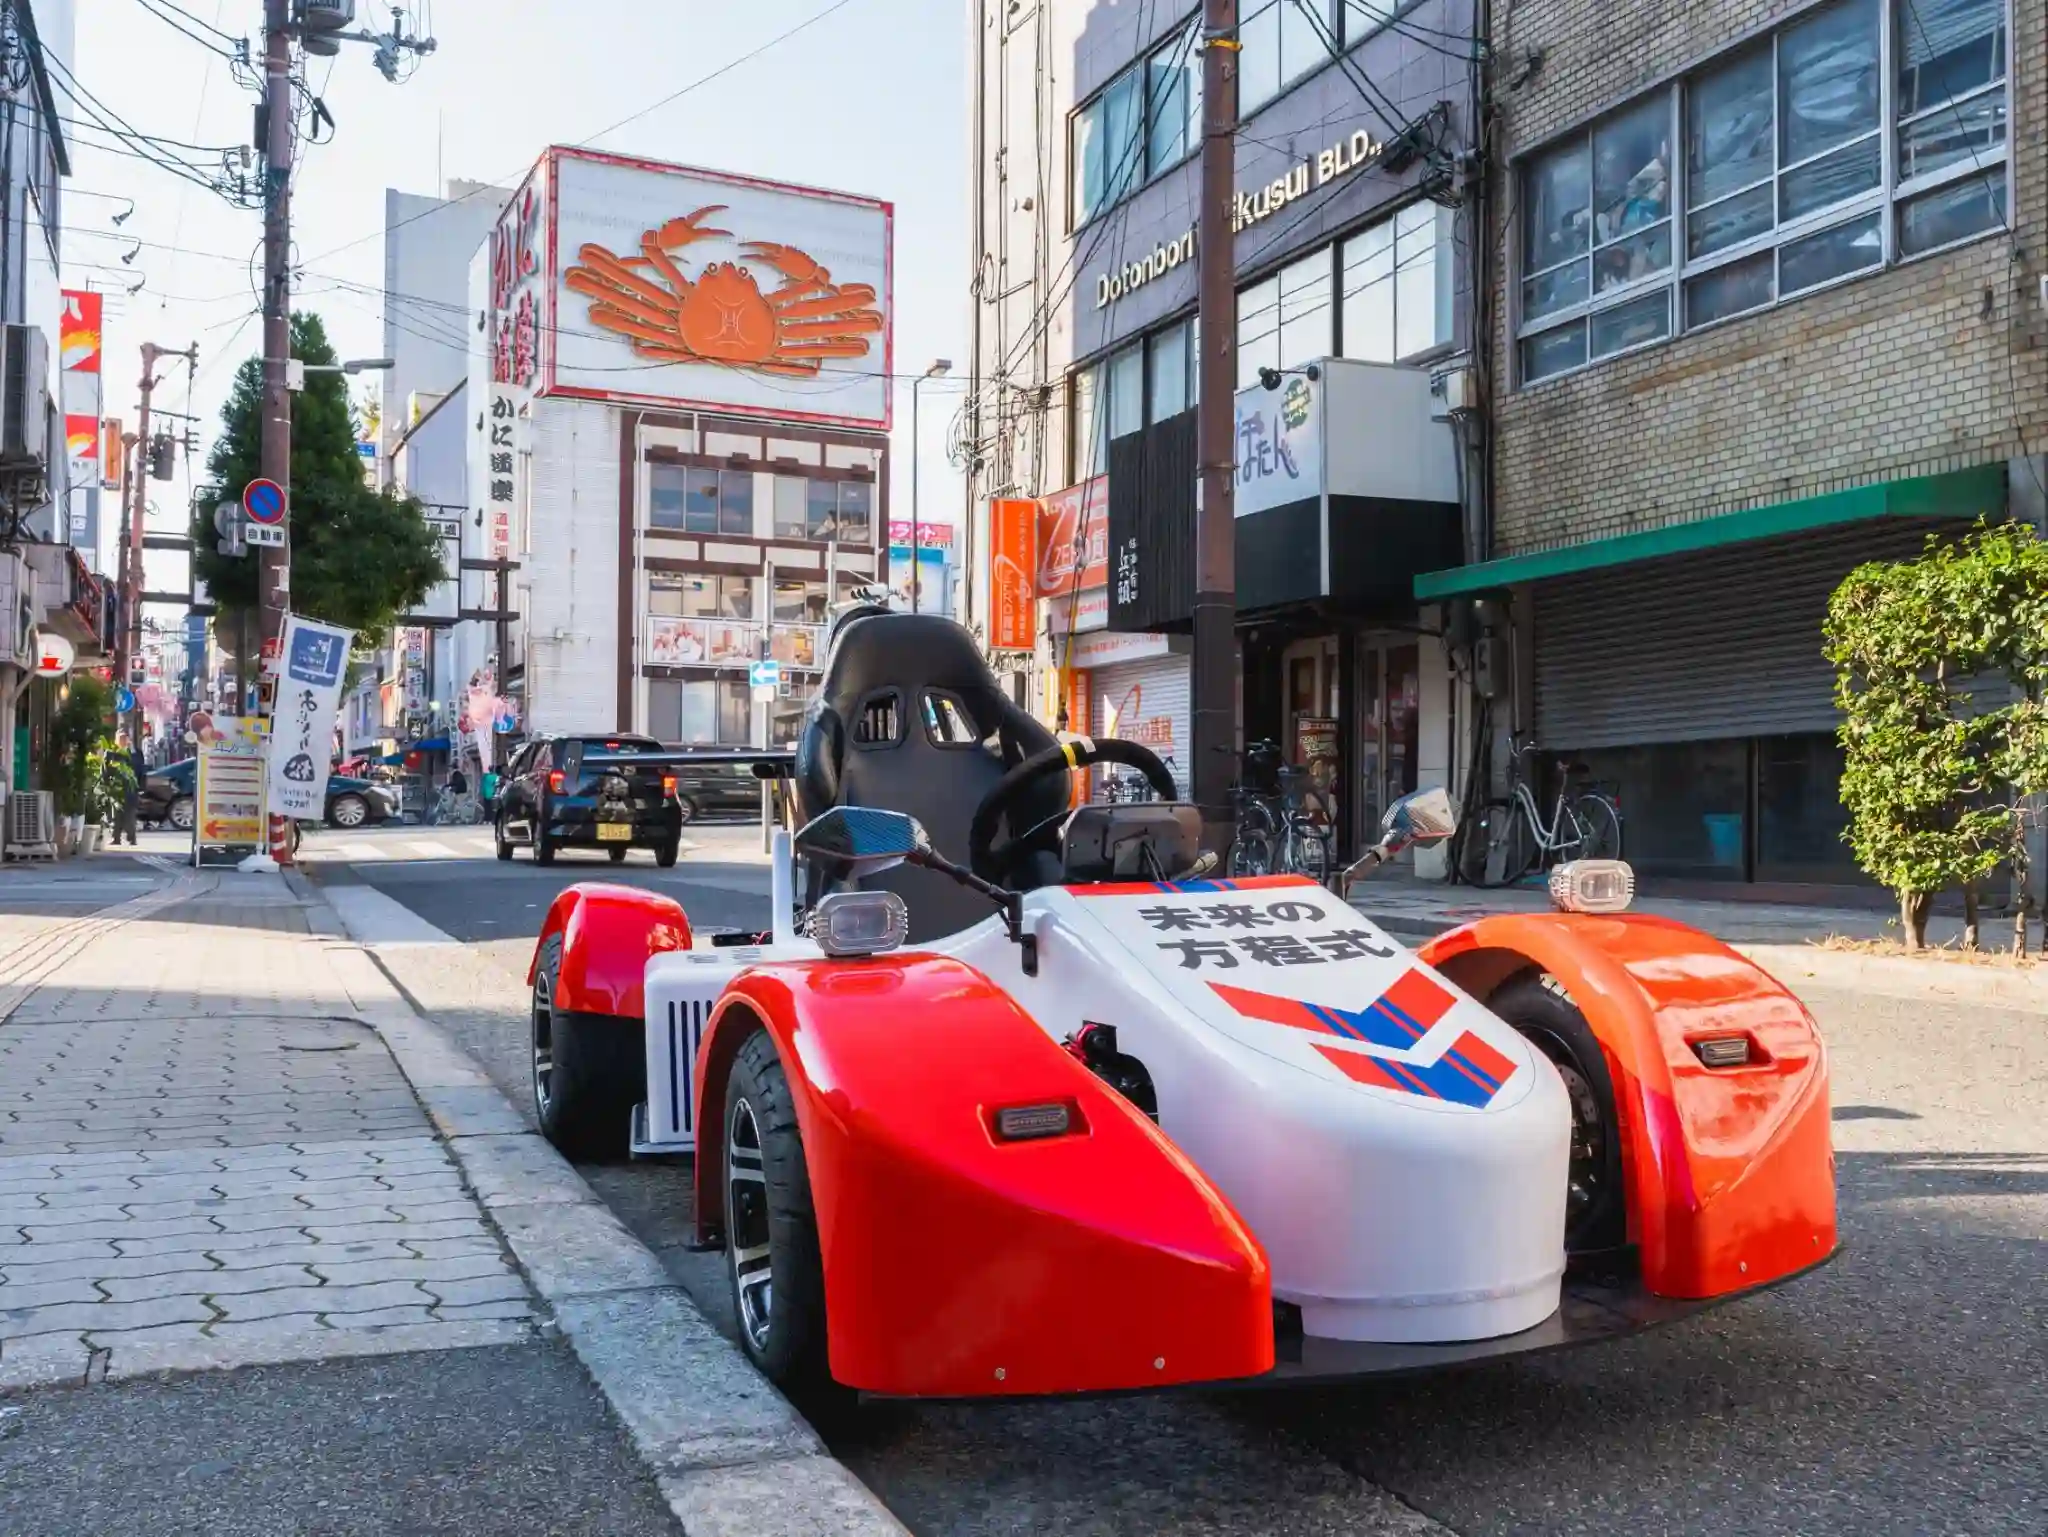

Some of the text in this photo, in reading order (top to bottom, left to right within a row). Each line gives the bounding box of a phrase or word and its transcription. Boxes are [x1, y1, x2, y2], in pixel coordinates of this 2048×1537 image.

[1096, 221, 1196, 308] Dotonbori
[1231, 156, 1310, 233] ikusui
[248, 527, 283, 542] 自動車
[1138, 901, 1326, 931] 未来の
[1156, 929, 1396, 970] 方程式
